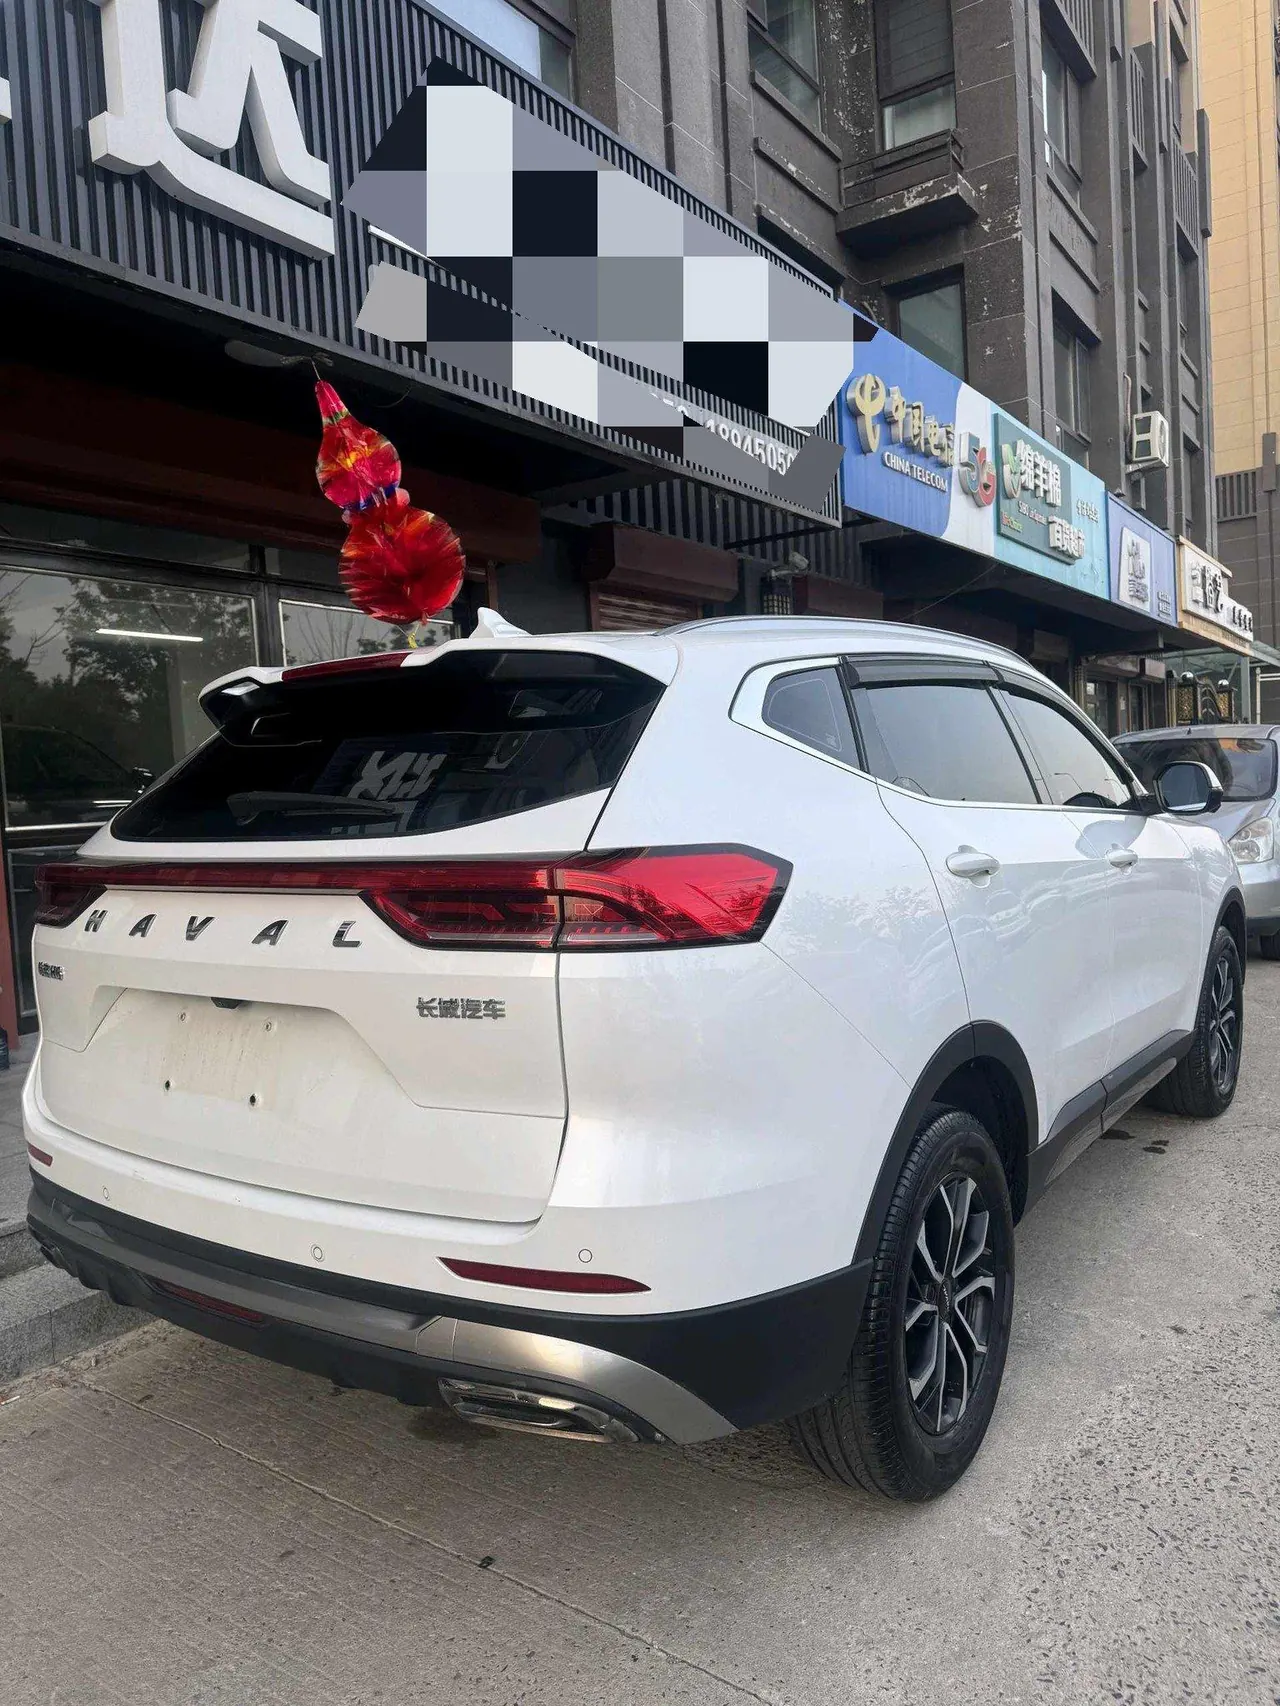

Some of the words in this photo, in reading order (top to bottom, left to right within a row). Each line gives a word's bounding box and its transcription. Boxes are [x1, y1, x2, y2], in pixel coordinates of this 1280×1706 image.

[883, 450, 911, 477] CHINA
[912, 463, 949, 493] TELECOM
[959, 432, 997, 507] 5G
[84, 909, 362, 948] HAVAL
[416, 997, 506, 1020] 长城汽车
